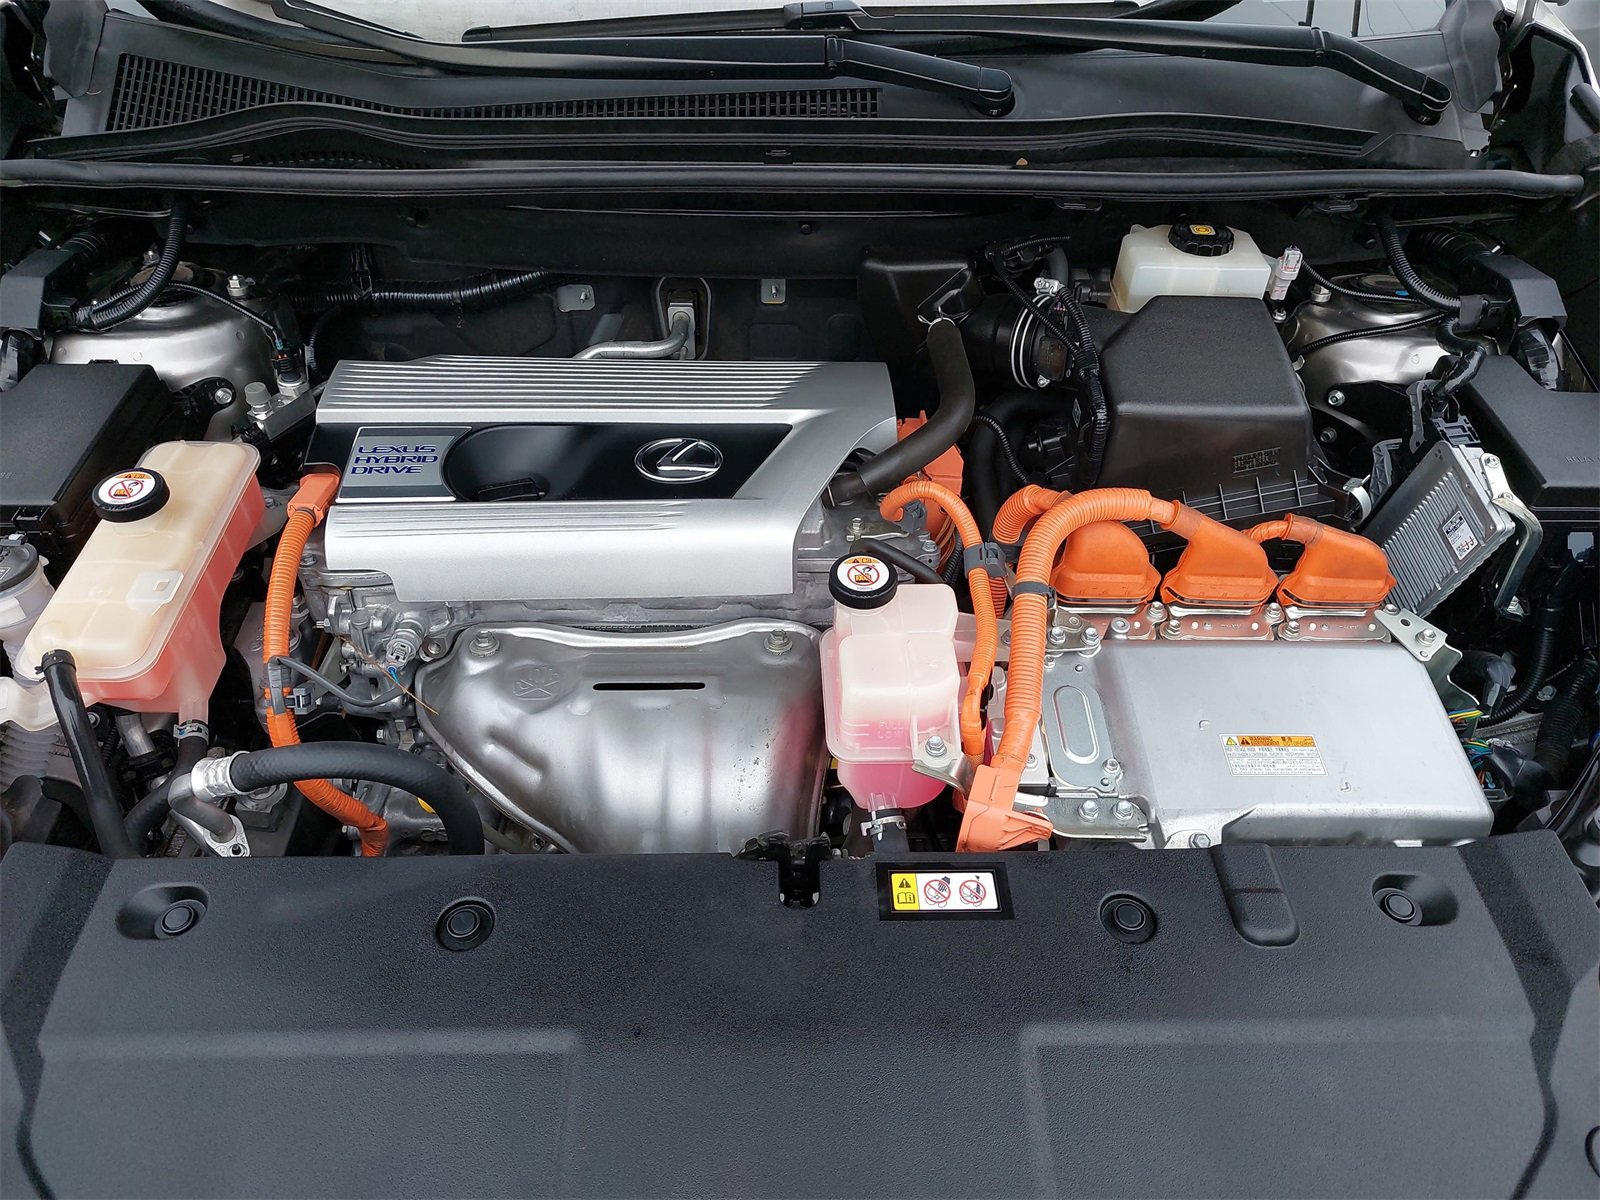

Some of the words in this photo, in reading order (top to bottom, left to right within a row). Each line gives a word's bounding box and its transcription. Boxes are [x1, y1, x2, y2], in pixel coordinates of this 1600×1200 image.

[358, 445, 436, 454] LEXUS
[354, 455, 439, 464] HYBRID
[351, 465, 423, 475] DRIVE
